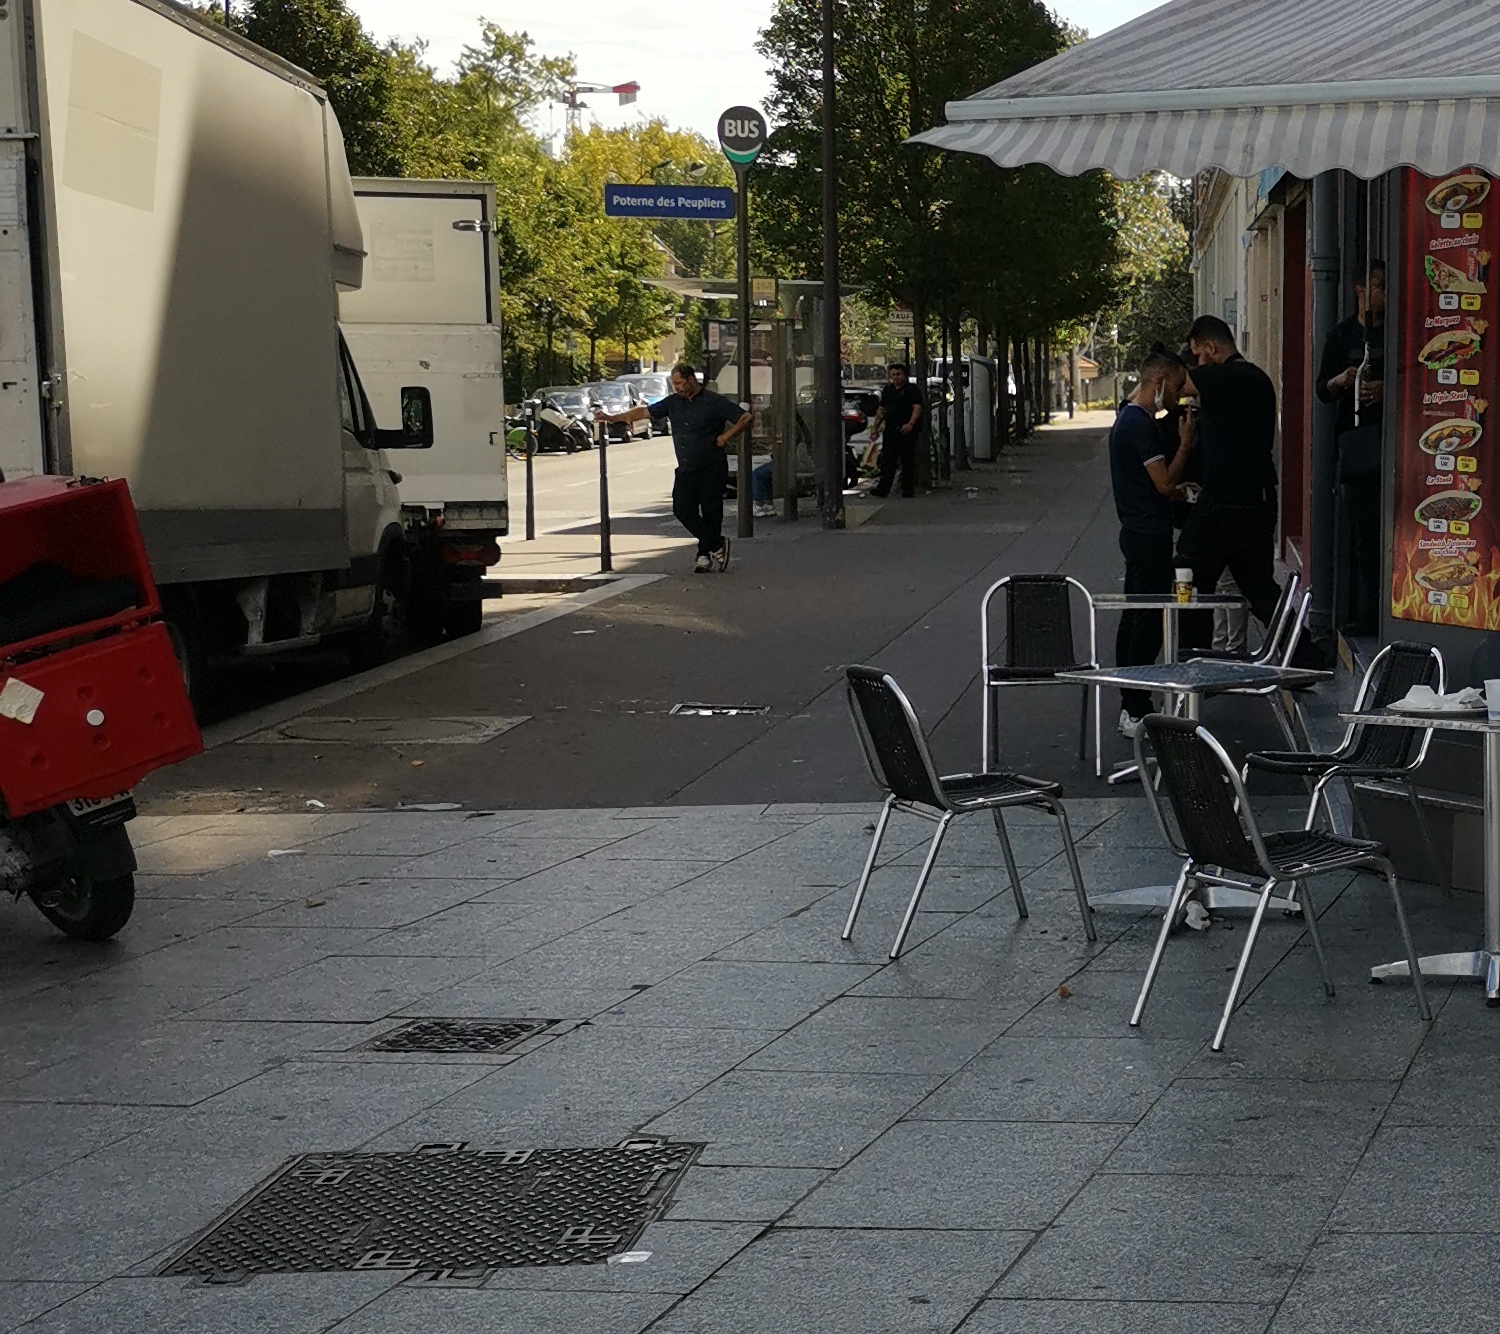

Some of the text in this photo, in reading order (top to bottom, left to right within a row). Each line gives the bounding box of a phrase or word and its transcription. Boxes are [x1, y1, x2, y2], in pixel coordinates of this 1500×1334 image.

[724, 119, 760, 138] BUS
[612, 194, 727, 211] Poterne des Peupliers
